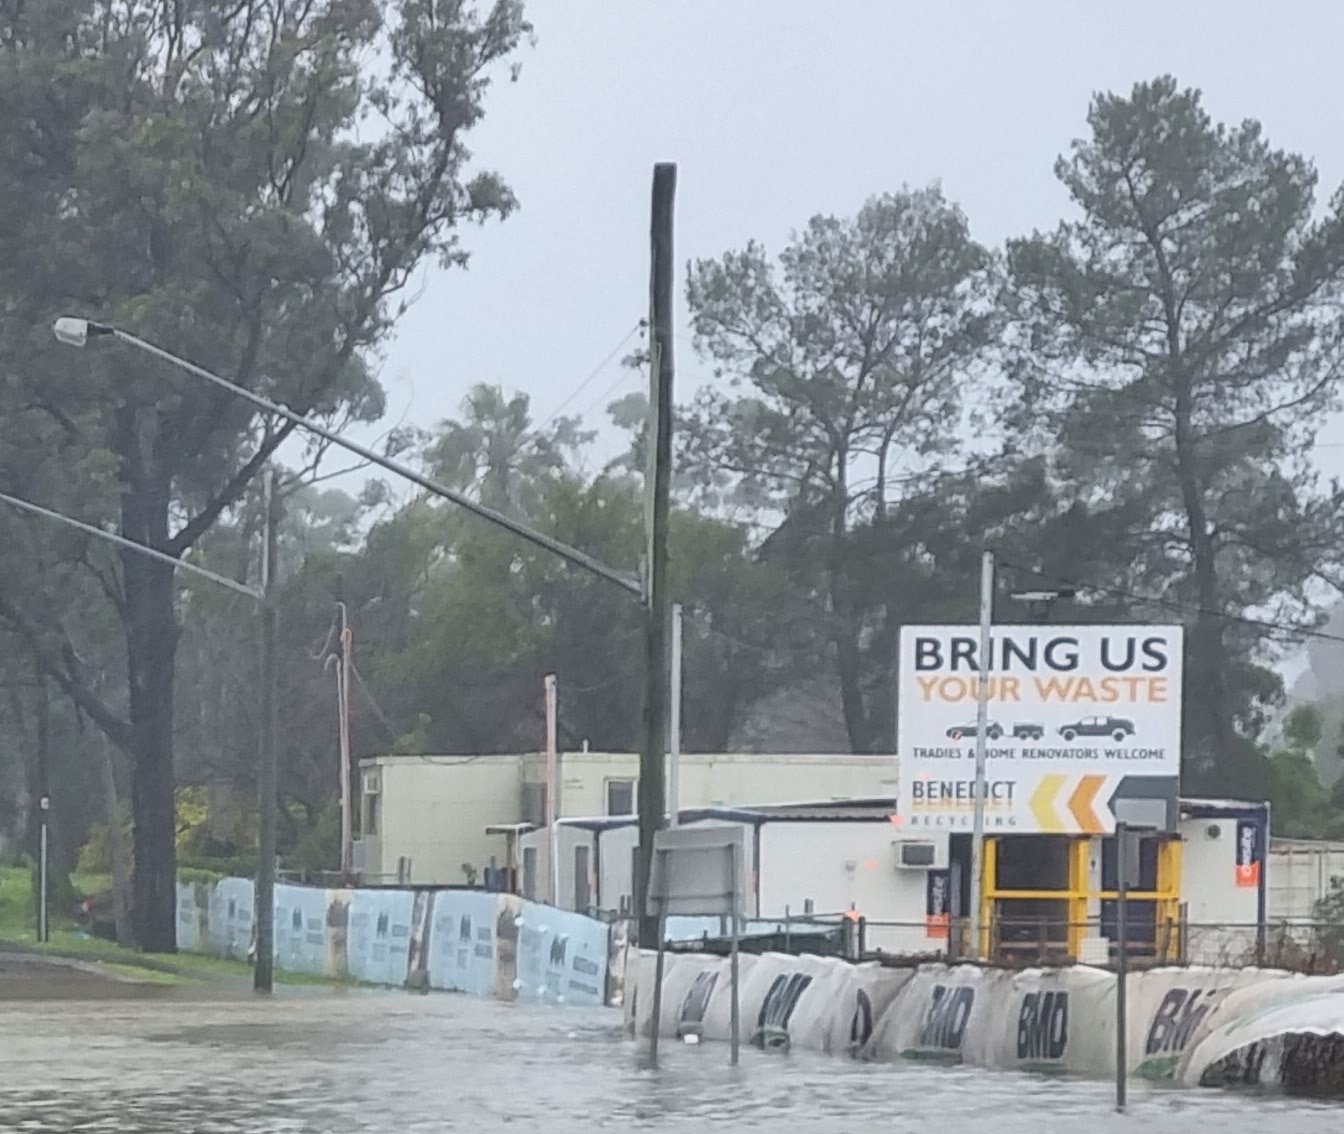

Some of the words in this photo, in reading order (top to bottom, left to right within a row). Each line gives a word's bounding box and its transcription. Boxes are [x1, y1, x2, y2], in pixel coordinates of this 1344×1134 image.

[1100, 636, 1168, 672] US
[916, 675, 1021, 703] YOUR
[1033, 675, 1169, 703] WASTE
[912, 747, 962, 760] TRADIES
[967, 747, 977, 760] &
[1021, 748, 1099, 761] RENOVATORS
[1104, 748, 1166, 761] WELCOME
[912, 781, 1016, 800] BENEDICT
[1017, 991, 1069, 1059] BMD
